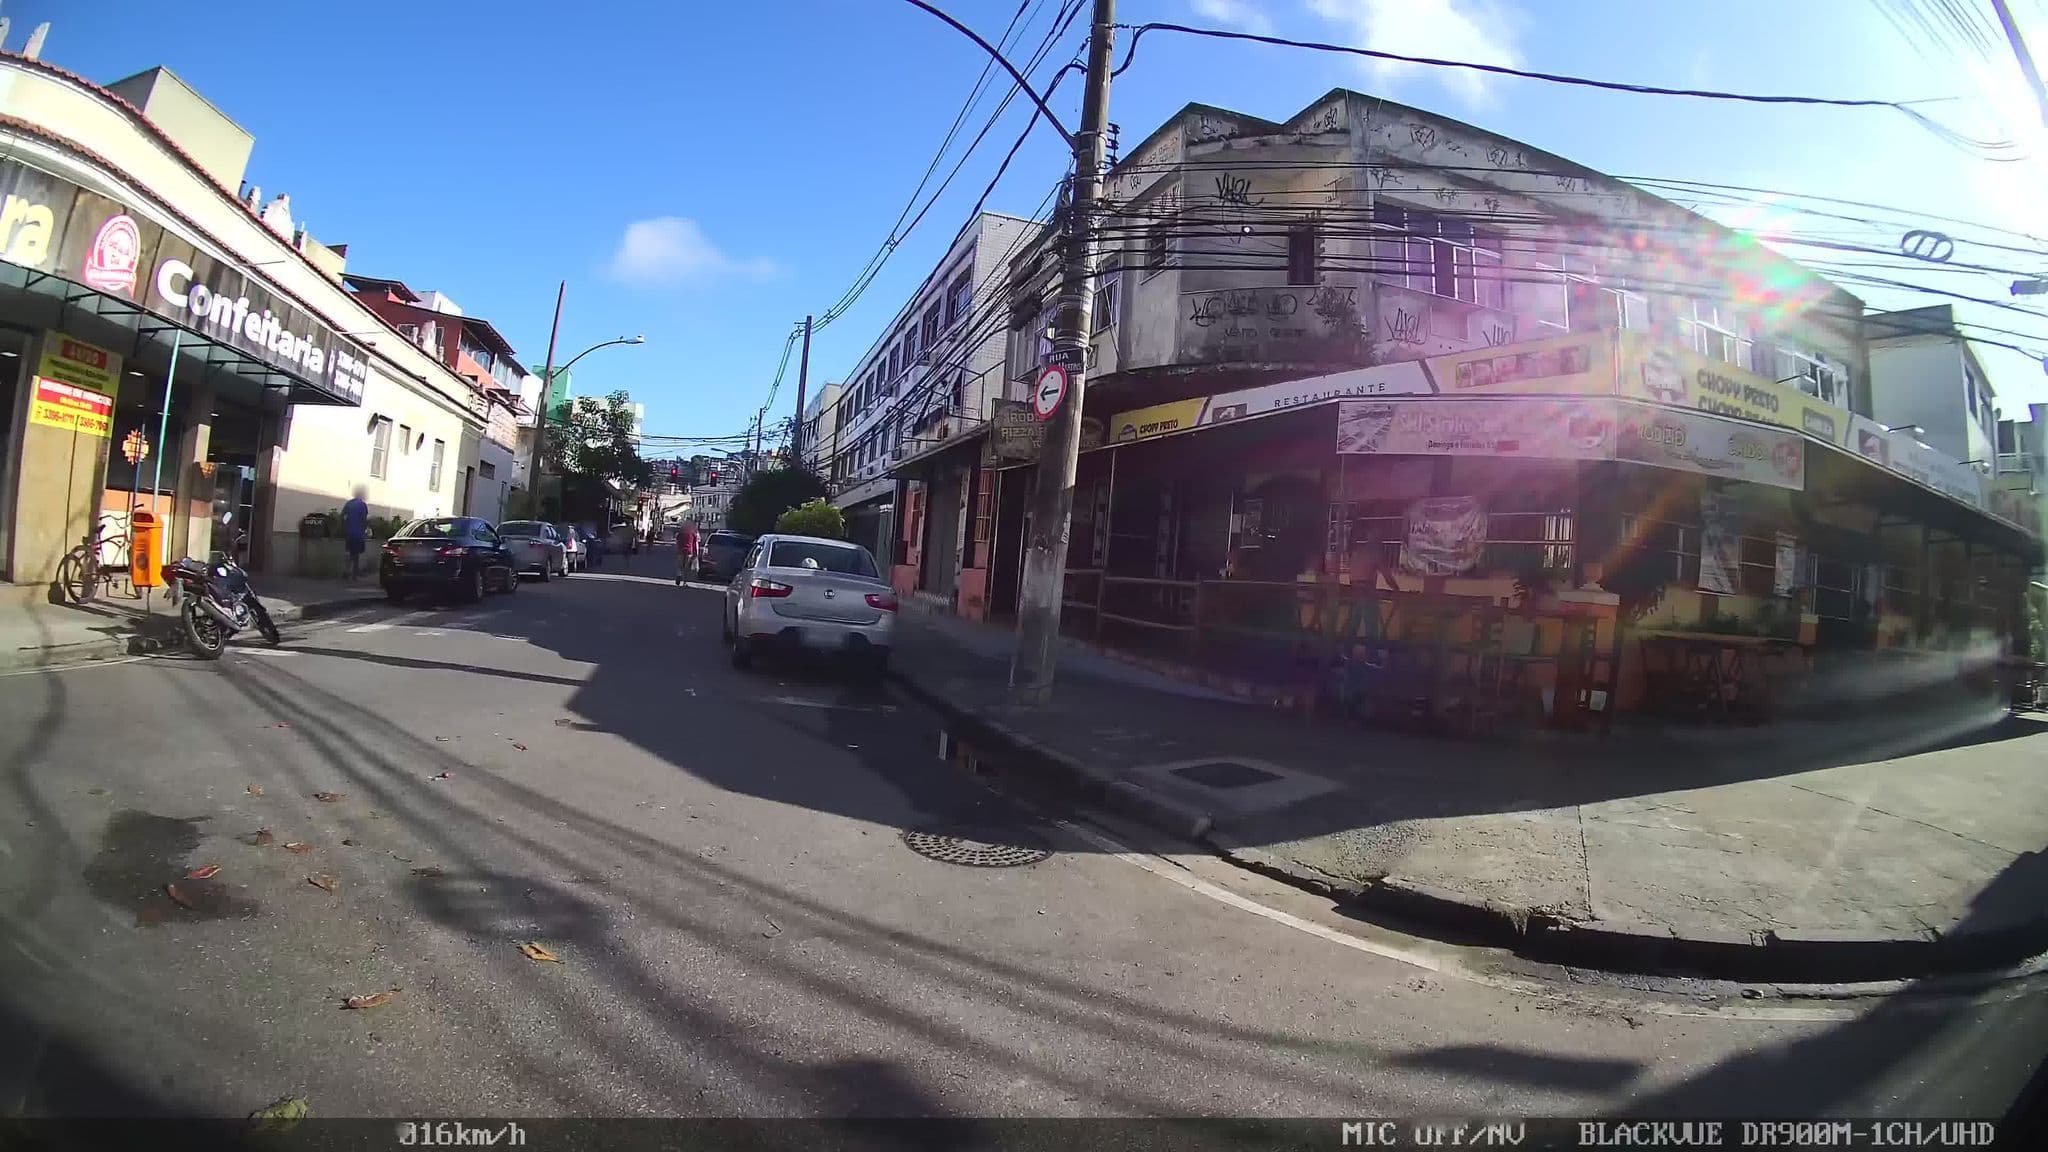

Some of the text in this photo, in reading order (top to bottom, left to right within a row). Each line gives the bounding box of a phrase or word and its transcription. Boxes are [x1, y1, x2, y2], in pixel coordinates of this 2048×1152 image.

[157, 259, 324, 374] Confeitaria
[1049, 352, 1070, 364] RUA
[1274, 382, 1386, 408] RESTAURANTE
[1160, 419, 1178, 431] PRETO
